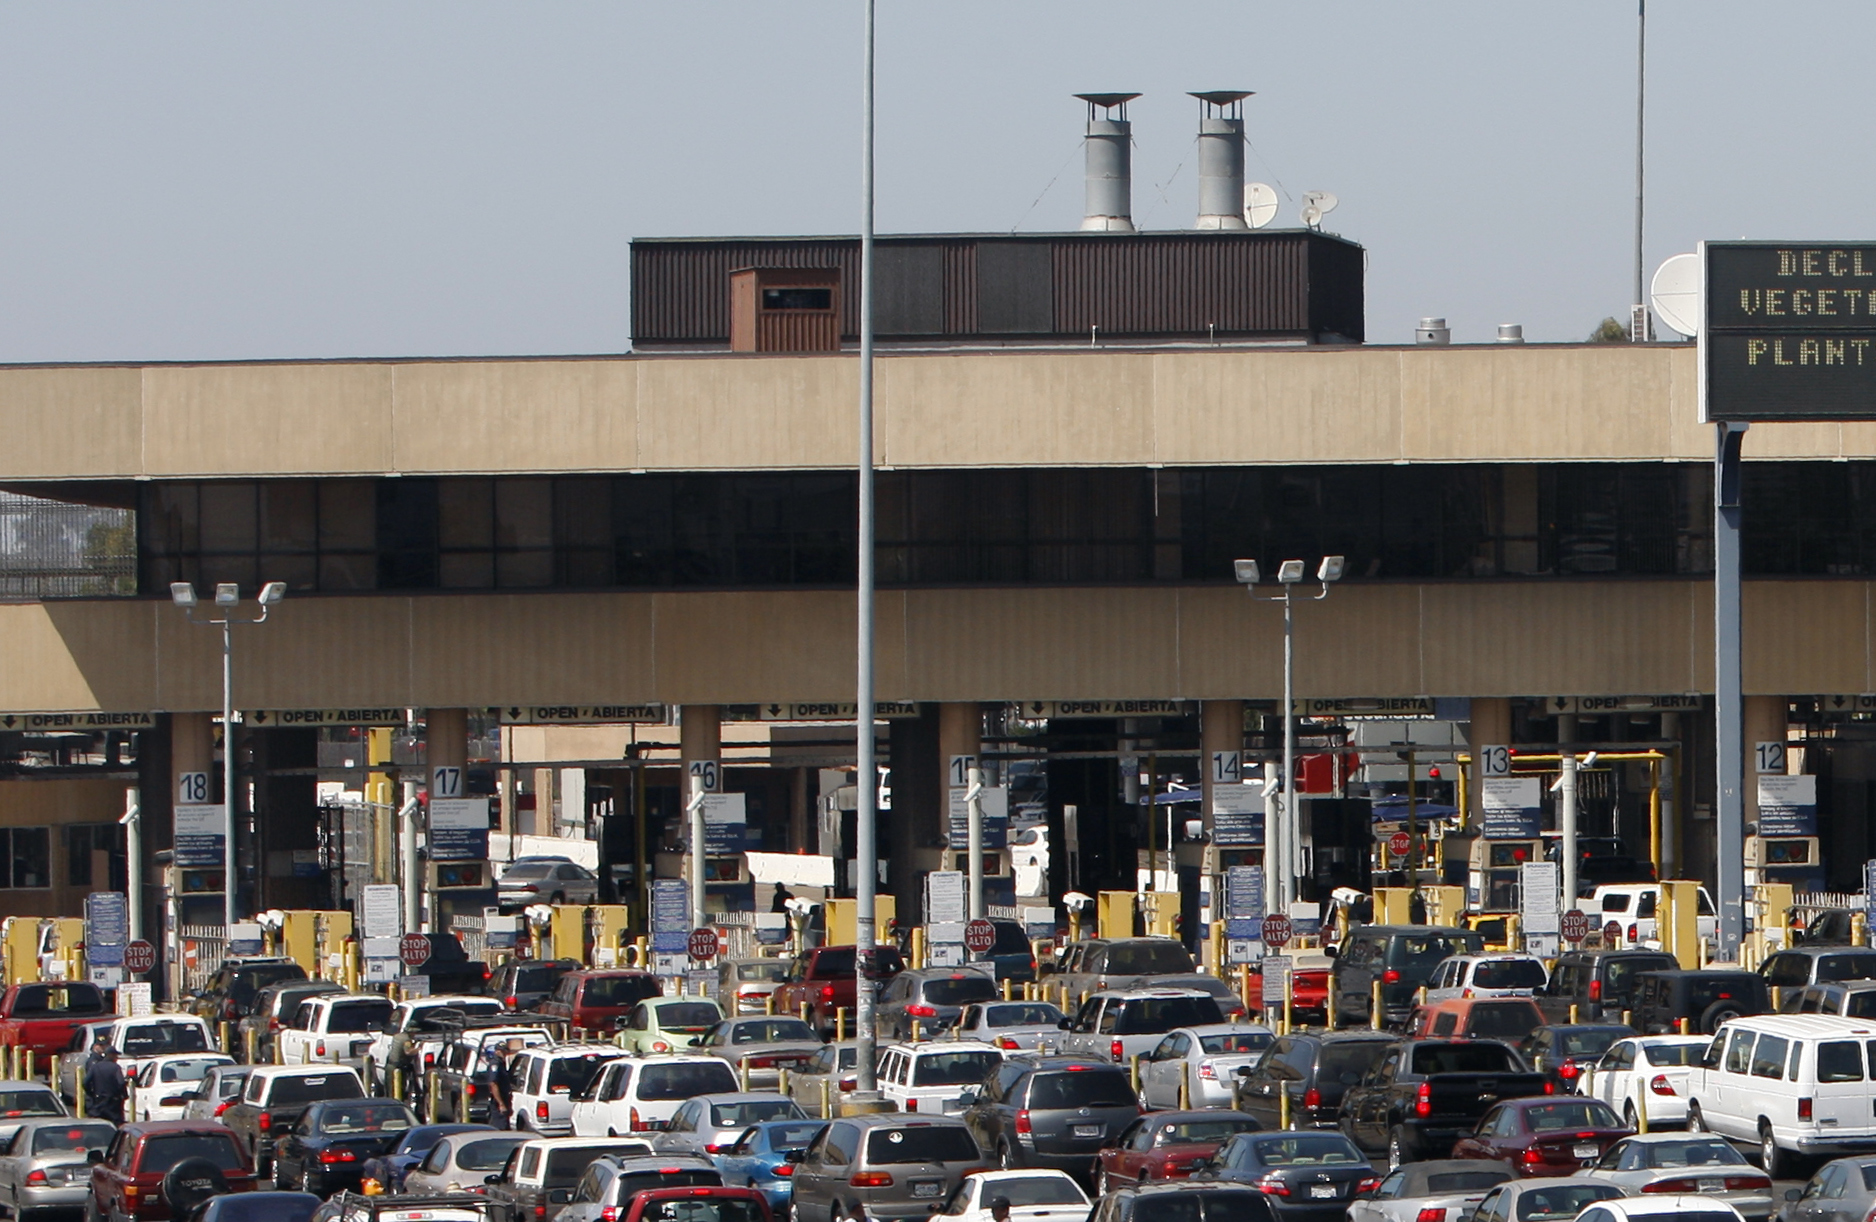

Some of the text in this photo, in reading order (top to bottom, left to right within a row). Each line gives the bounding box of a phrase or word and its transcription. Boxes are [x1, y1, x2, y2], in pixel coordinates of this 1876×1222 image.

[537, 706, 655, 719] OPEN ABIERTA
[797, 704, 838, 716] OPEN
[1060, 701, 1178, 714] OPEN ABIERTA
[32, 712, 151, 726] OPEN ABIERTA
[283, 708, 401, 722] OPEN ABIERTA
[1481, 746, 1509, 774] 13
[1756, 743, 1783, 771] 12
[1212, 755, 1240, 780] 14
[180, 774, 207, 800] 18
[435, 769, 462, 795] 17
[1389, 839, 1410, 850] STOP
[1264, 921, 1290, 931] STOP
[1562, 916, 1588, 928] STOP
[967, 924, 993, 936] STOP
[1563, 928, 1588, 939] ALTO
[690, 934, 717, 944] STOP
[967, 937, 992, 948] ALTO
[1265, 932, 1289, 942] ALTO
[129, 945, 151, 956] STOP
[402, 940, 427, 951] STOP
[691, 945, 717, 956] ALTO
[130, 957, 152, 968] ALTO
[402, 952, 427, 963] ALTO
[180, 1178, 212, 1187] TOYOTA
